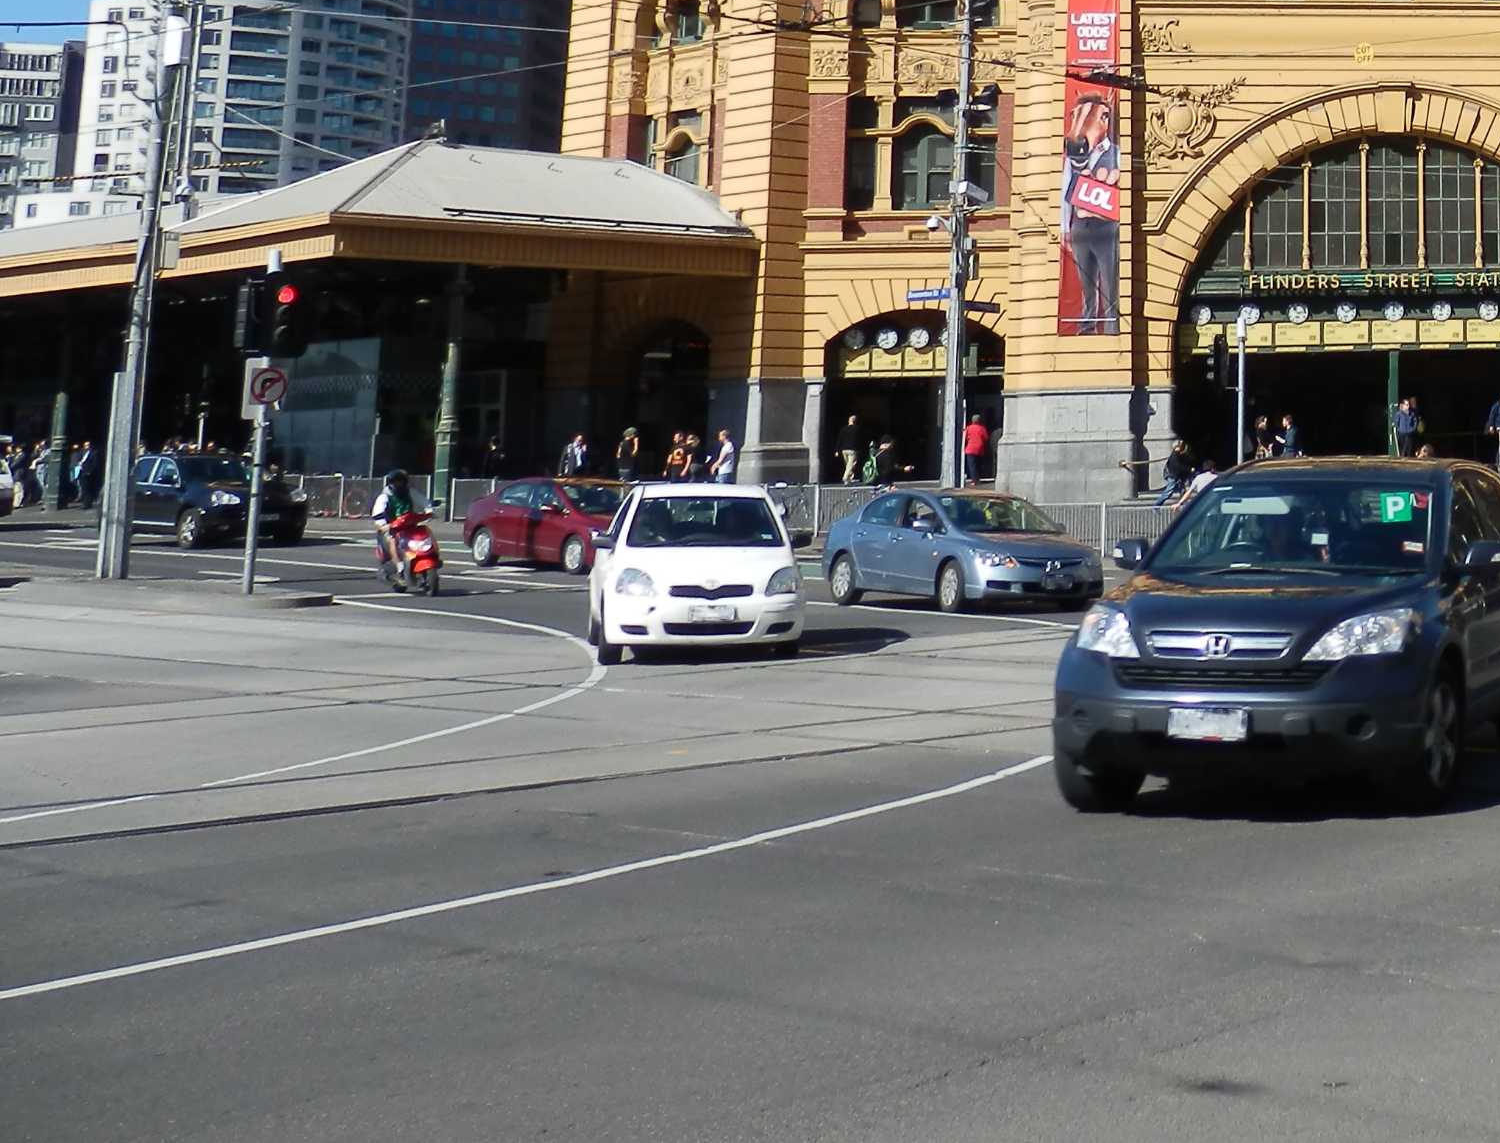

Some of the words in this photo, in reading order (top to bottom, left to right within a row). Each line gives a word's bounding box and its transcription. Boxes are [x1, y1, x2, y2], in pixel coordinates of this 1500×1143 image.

[1070, 13, 1117, 25] LATEST
[1076, 25, 1110, 38] ODDS
[1078, 38, 1107, 51] LIVE
[1078, 181, 1113, 211] LOL
[1248, 273, 1341, 290] FLINDERS
[1363, 272, 1433, 289] STREET
[1386, 495, 1406, 520] P
